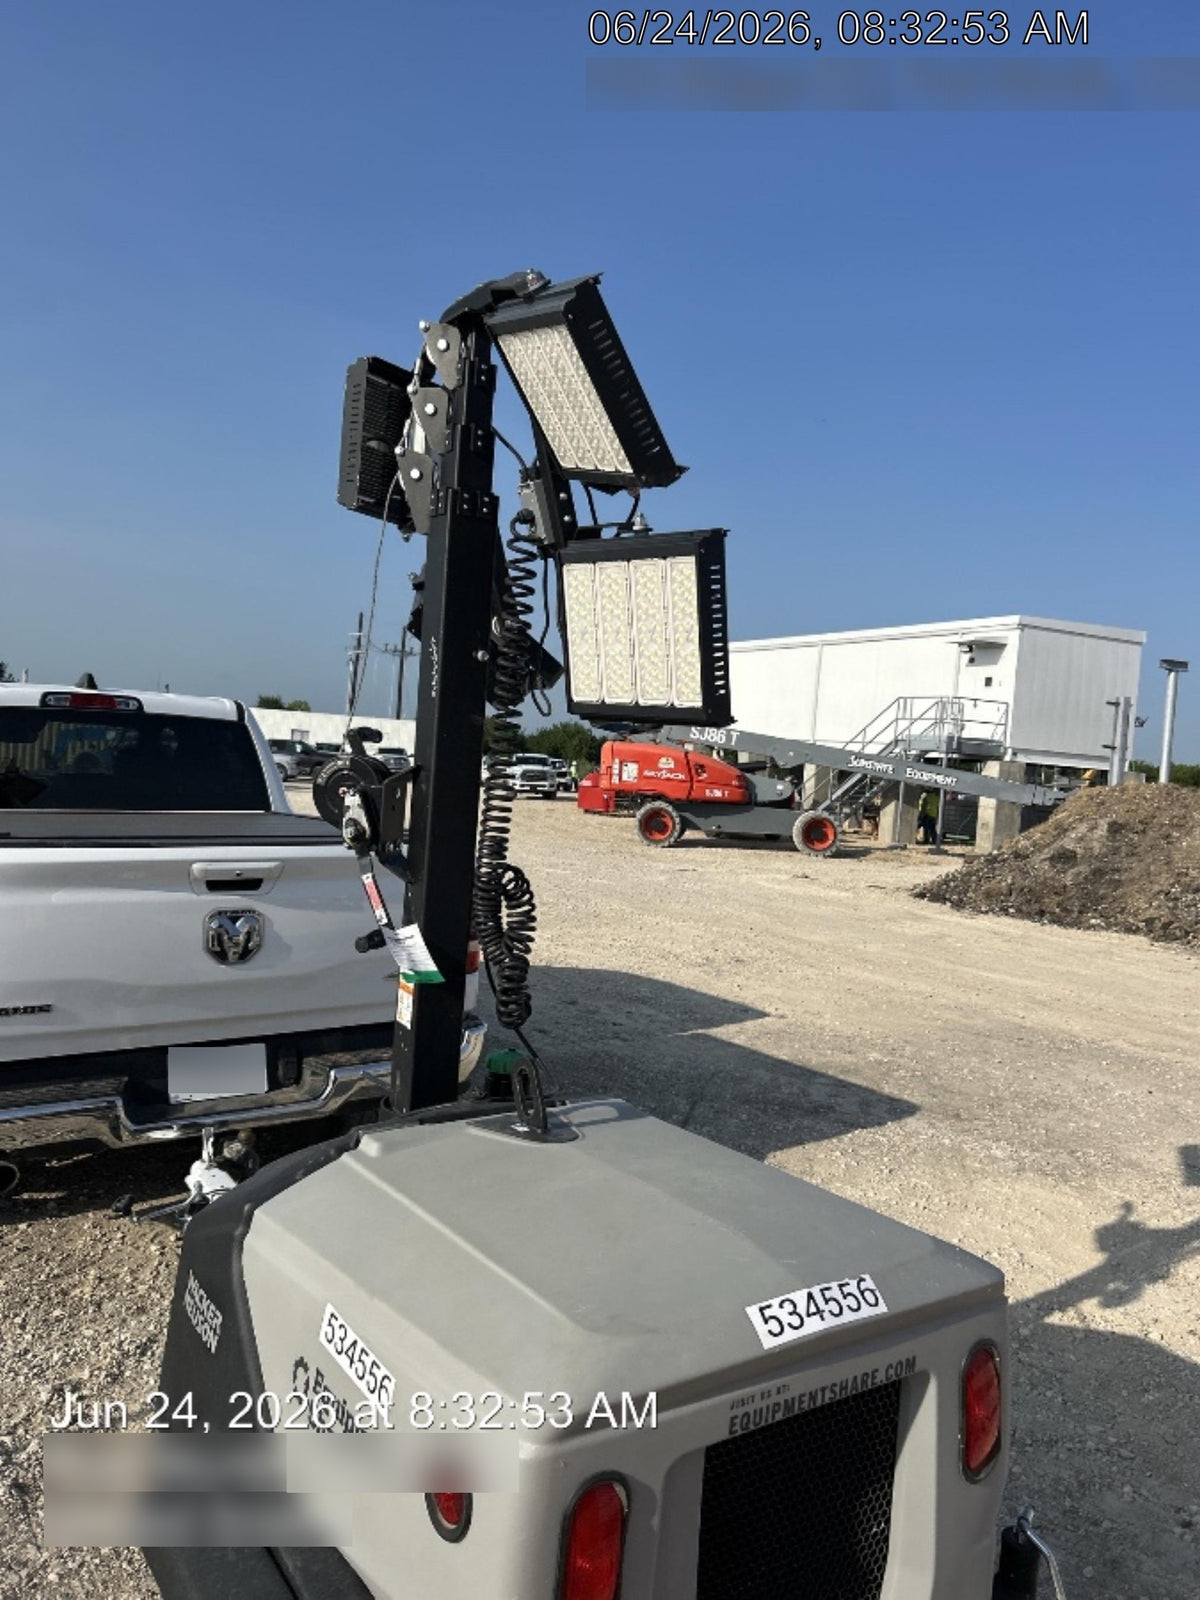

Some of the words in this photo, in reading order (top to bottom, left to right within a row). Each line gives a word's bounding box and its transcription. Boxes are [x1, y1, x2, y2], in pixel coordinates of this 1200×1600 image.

[689, 726, 726, 744] SJ86
[730, 730, 740, 746] T
[187, 1269, 223, 1337] WACKER
[757, 1276, 880, 1338] 534556
[324, 1312, 392, 1408] 534556
[728, 1355, 917, 1436] EQUIPMENTSHARE.COM
